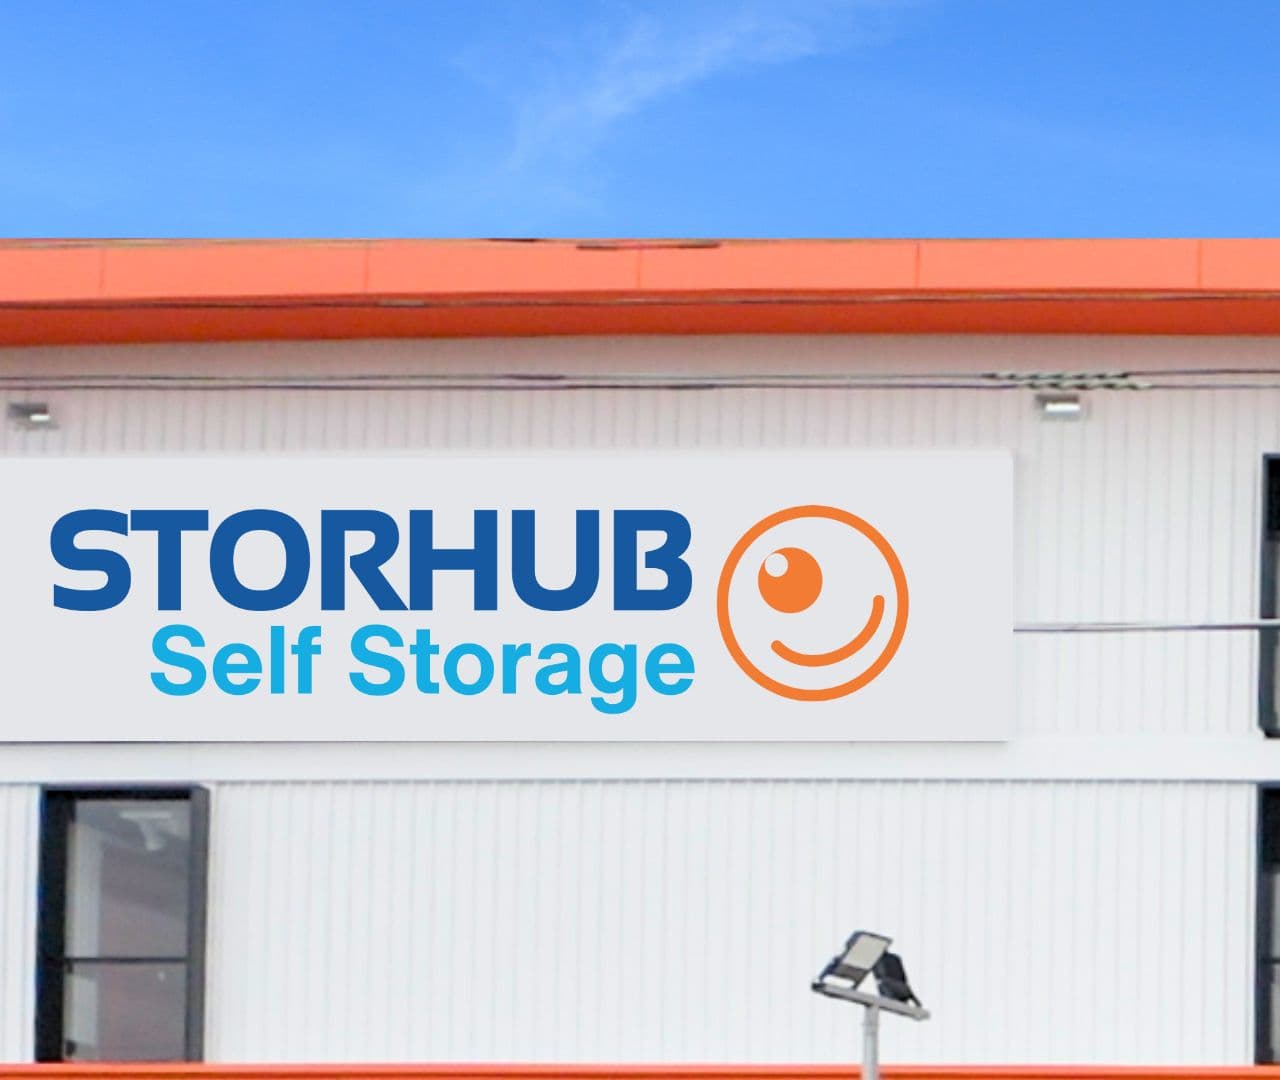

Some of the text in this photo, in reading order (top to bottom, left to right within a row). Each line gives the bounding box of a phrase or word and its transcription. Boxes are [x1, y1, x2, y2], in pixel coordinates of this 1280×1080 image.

[49, 508, 694, 612] STORHUB
[150, 624, 695, 715] Self Storage
